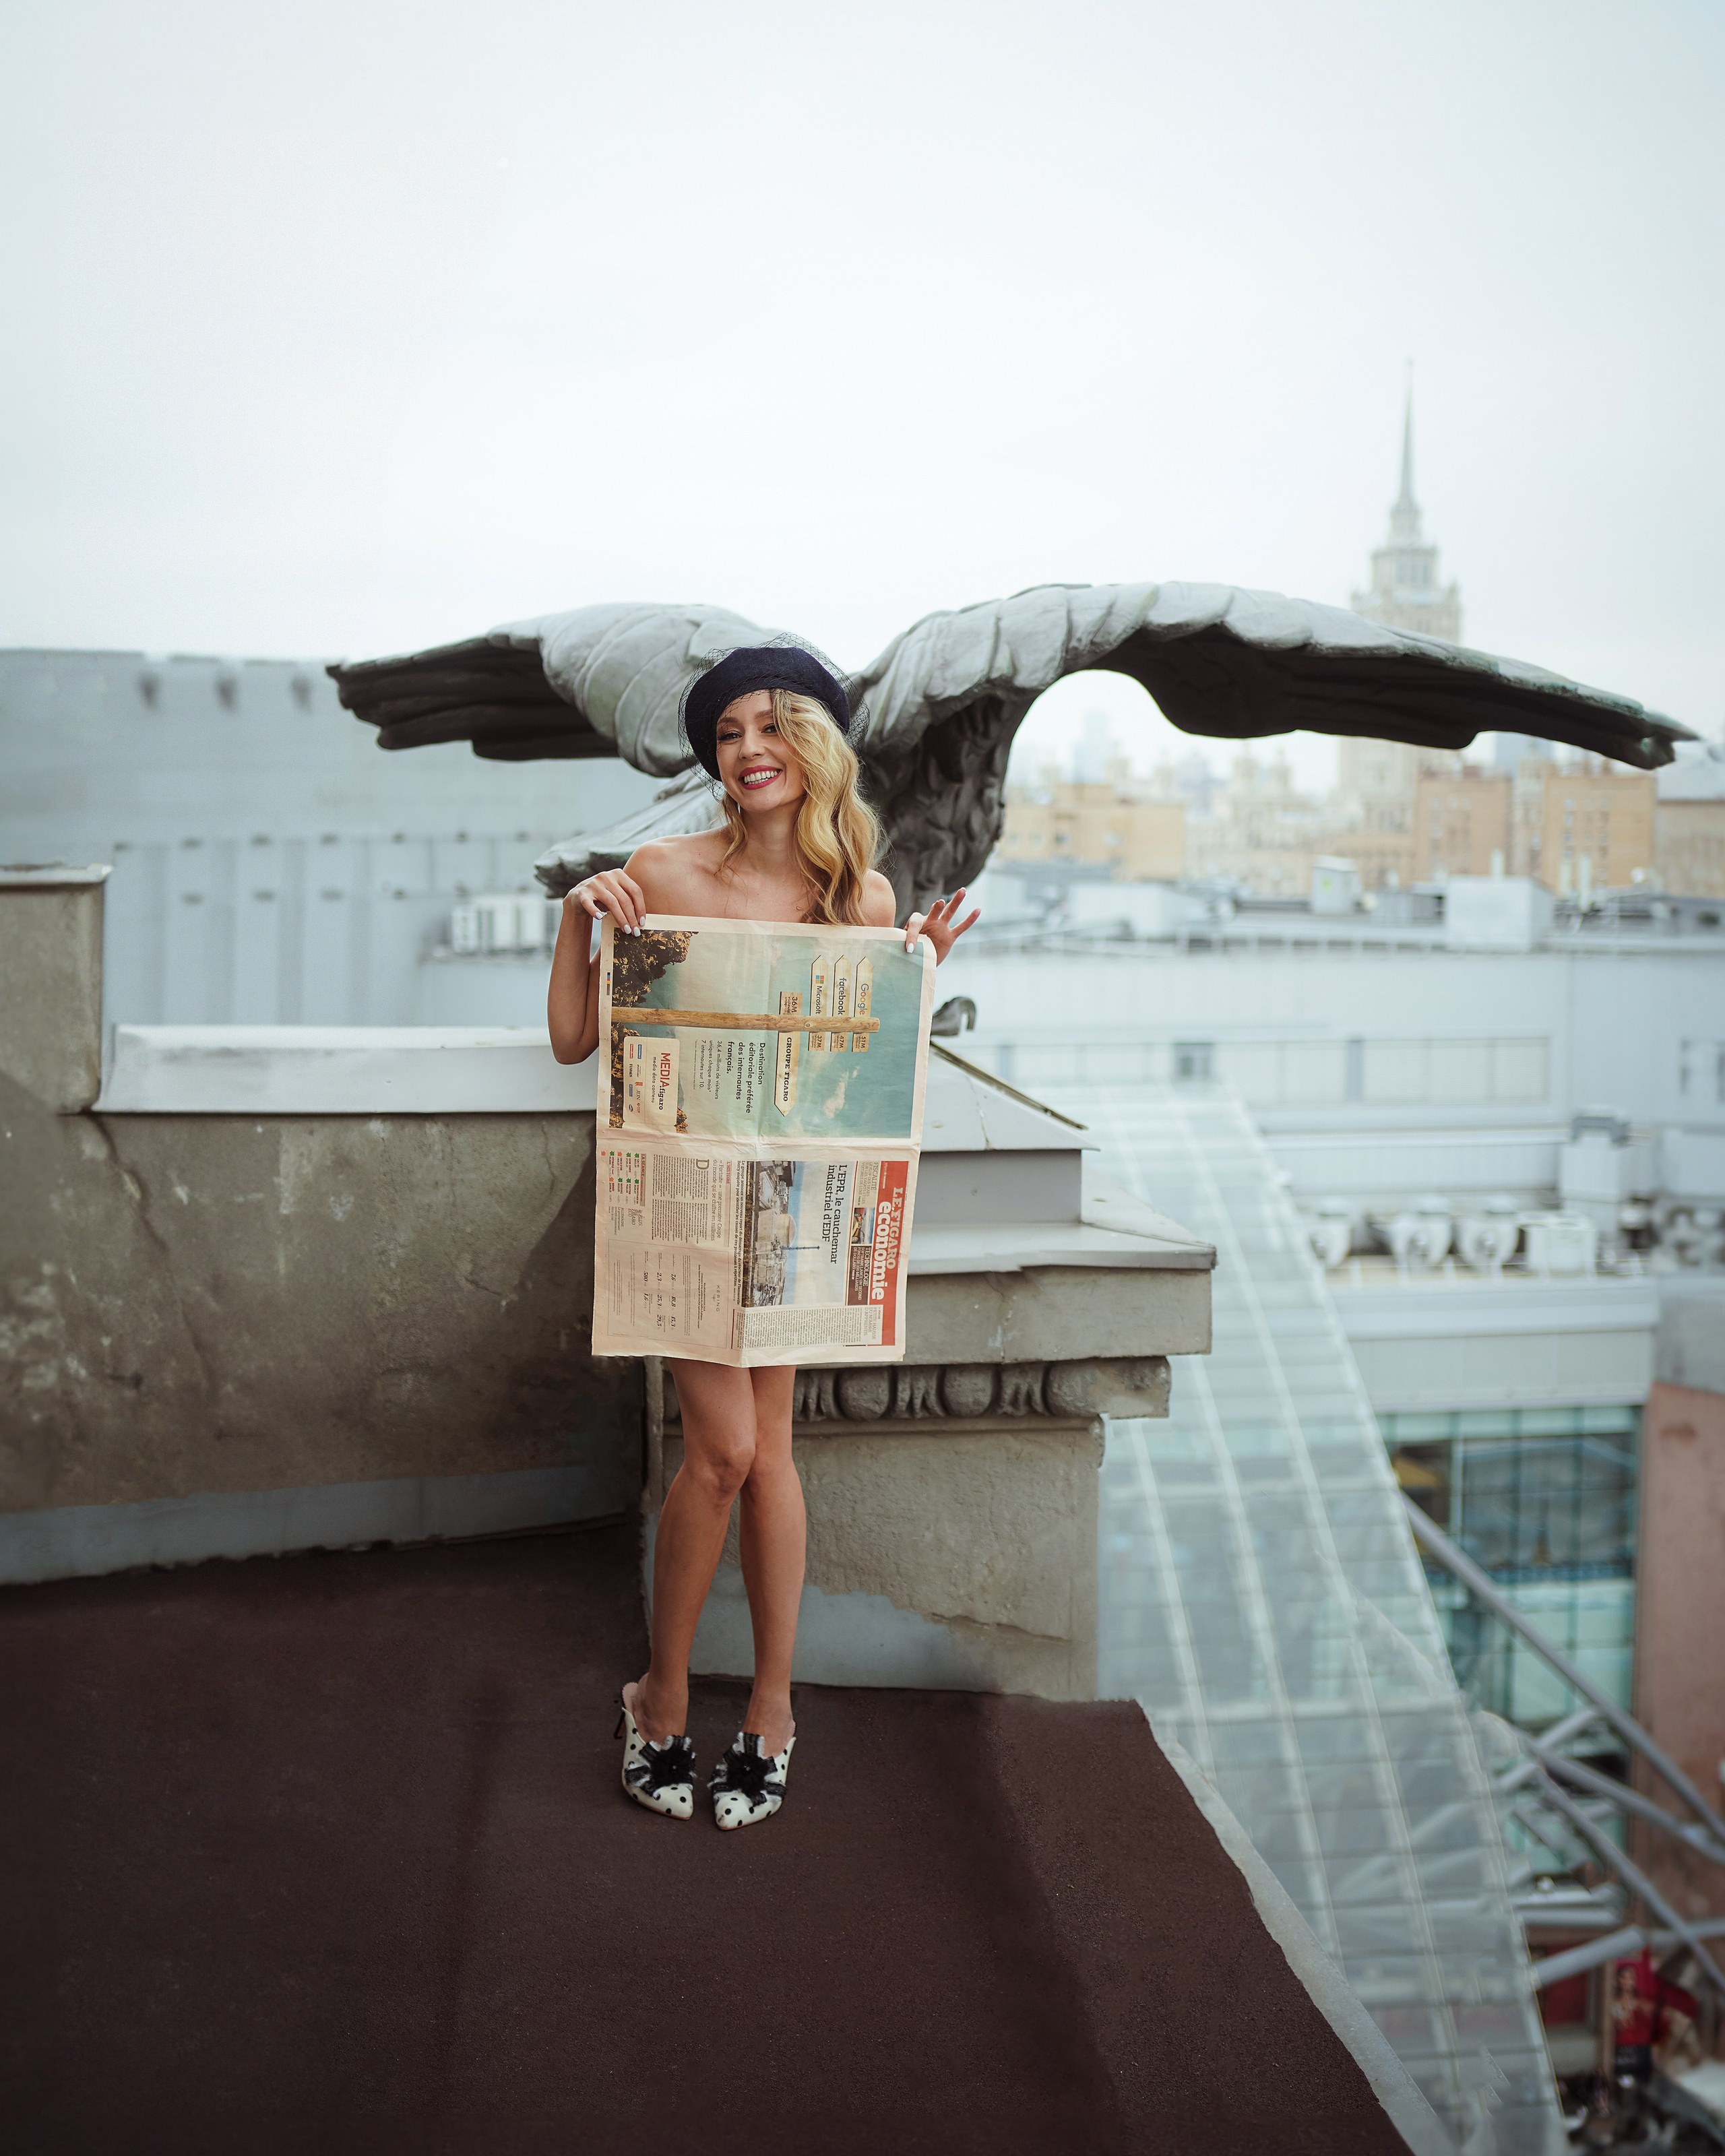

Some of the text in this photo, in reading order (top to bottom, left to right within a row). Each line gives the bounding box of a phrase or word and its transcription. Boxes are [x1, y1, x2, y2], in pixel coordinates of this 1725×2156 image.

[838, 978, 846, 1015] facebook
[857, 984, 869, 1015] Google
[725, 1042, 734, 1074] français.
[736, 1058, 744, 1100] internautes
[757, 1043, 766, 1085] Destination
[745, 1081, 754, 1114] préférée
[822, 1165, 837, 1242] industriel d'EDF
[830, 1164, 847, 1265] L'EPR, le cauchemar
[886, 1187, 903, 1269] LE FIGARO
[862, 1247, 871, 1287] TECHNOLOGIE
[871, 1201, 894, 1300] économie
